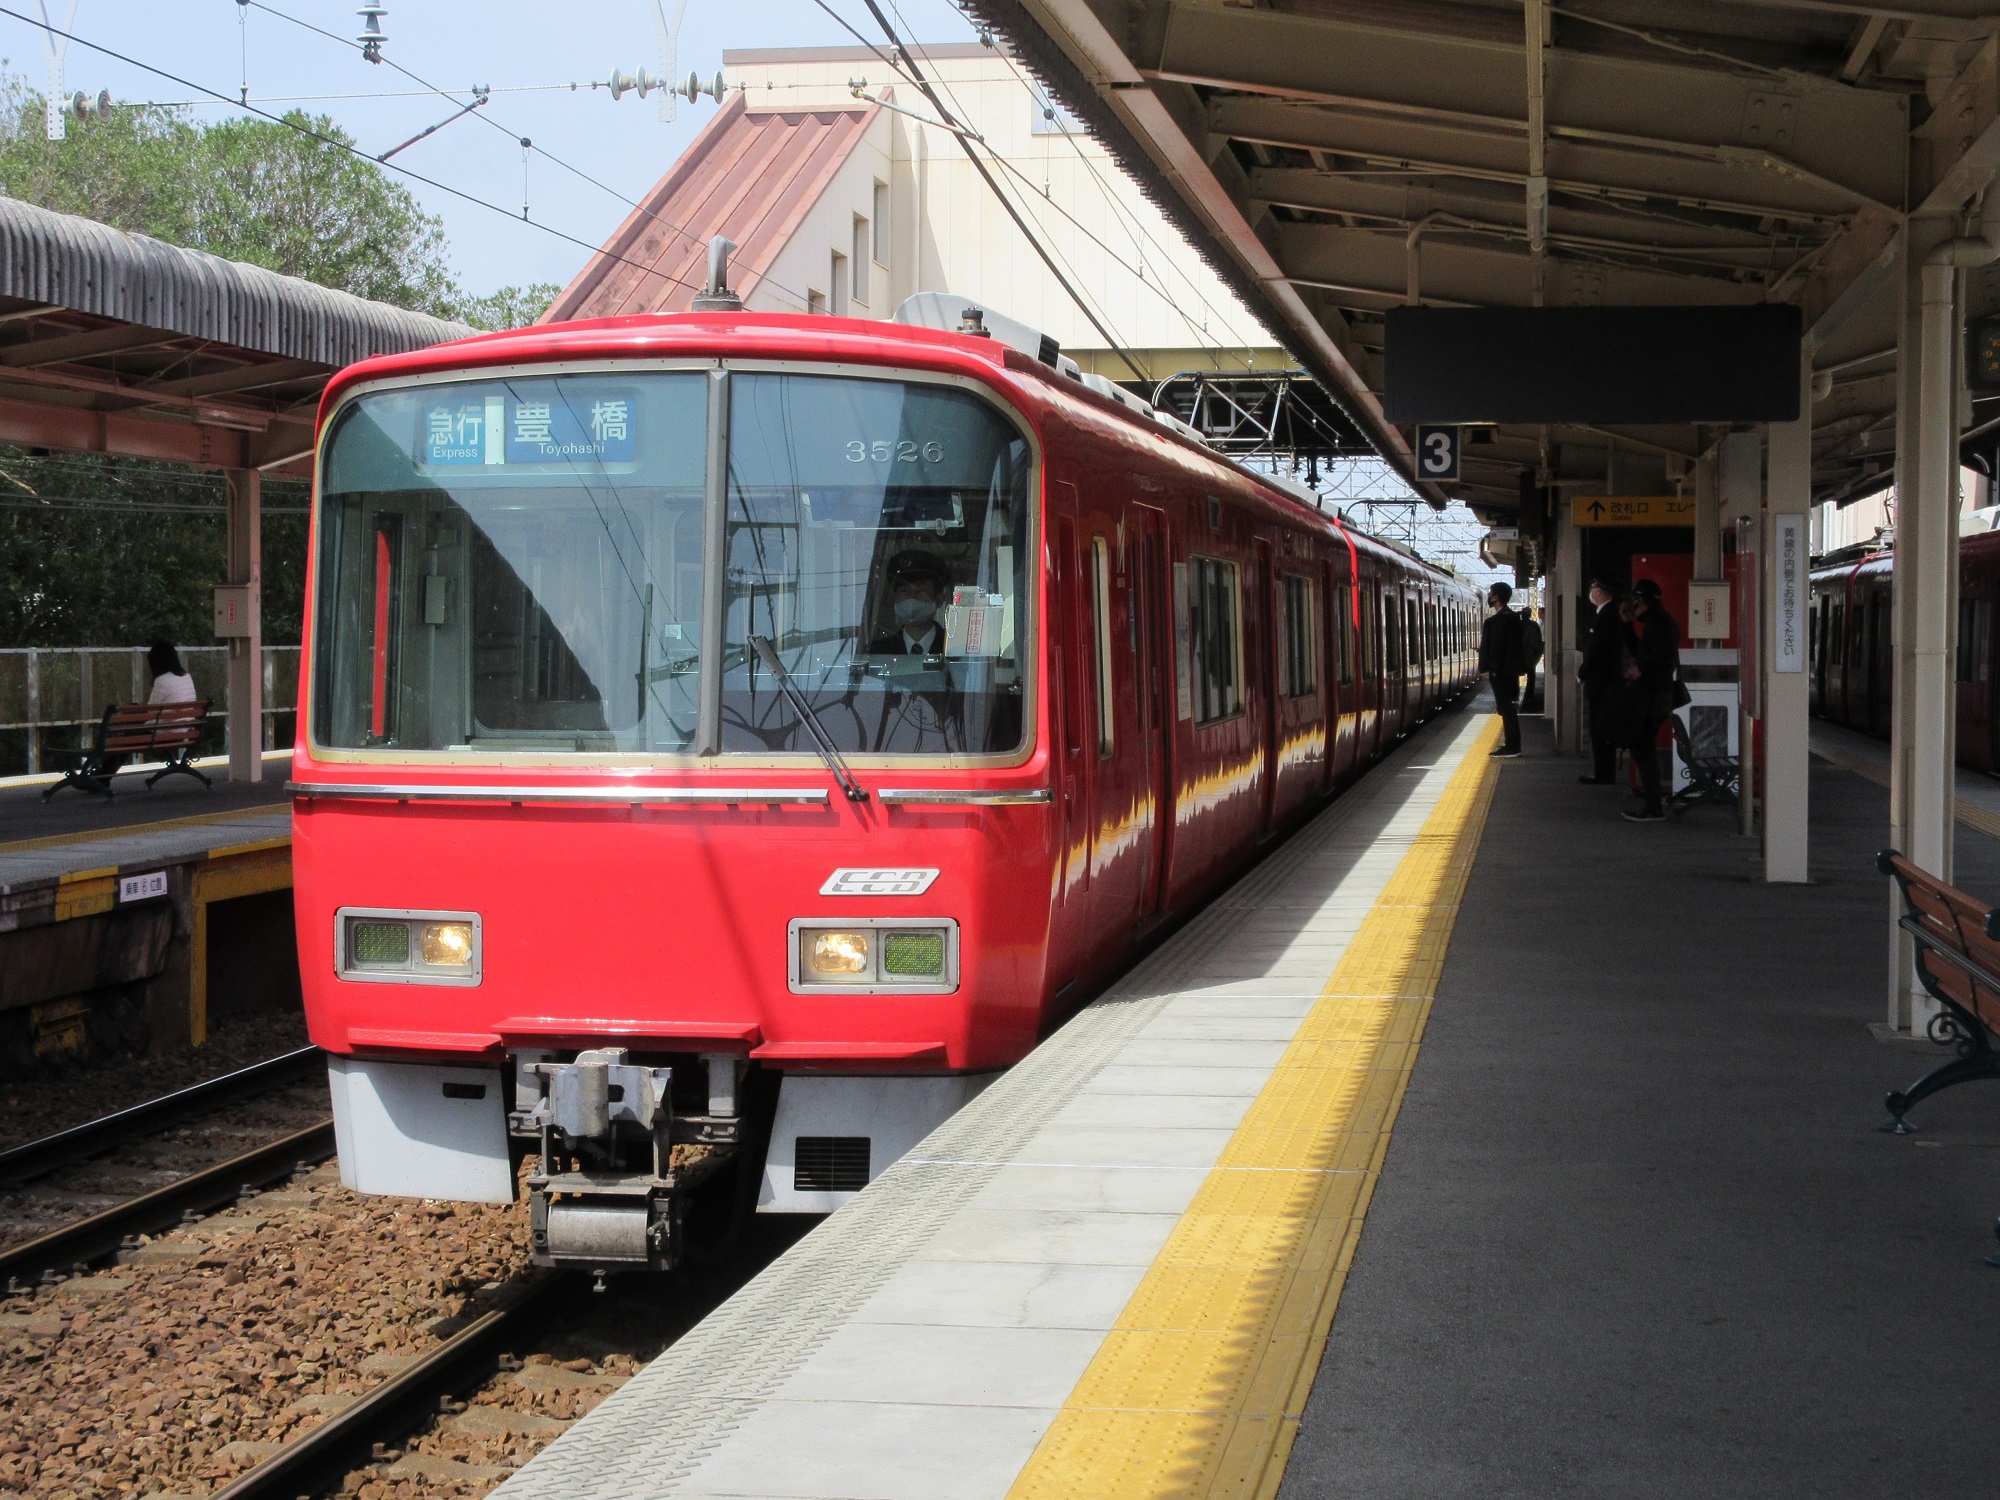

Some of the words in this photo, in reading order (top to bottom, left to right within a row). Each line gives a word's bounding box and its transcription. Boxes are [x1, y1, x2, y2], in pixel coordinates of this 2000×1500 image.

[1985, 350, 1993, 358] 9
[1991, 362, 1999, 370] 8
[429, 405, 483, 446] 急行
[514, 400, 628, 442] 豊橋
[433, 446, 478, 459] Express
[538, 442, 605, 456] Toyohashi
[844, 440, 945, 463] 3526
[1423, 432, 1452, 473] 3
[1610, 502, 1649, 514] 改札口
[1783, 527, 1795, 656] 黄線の内側でお待ちください
